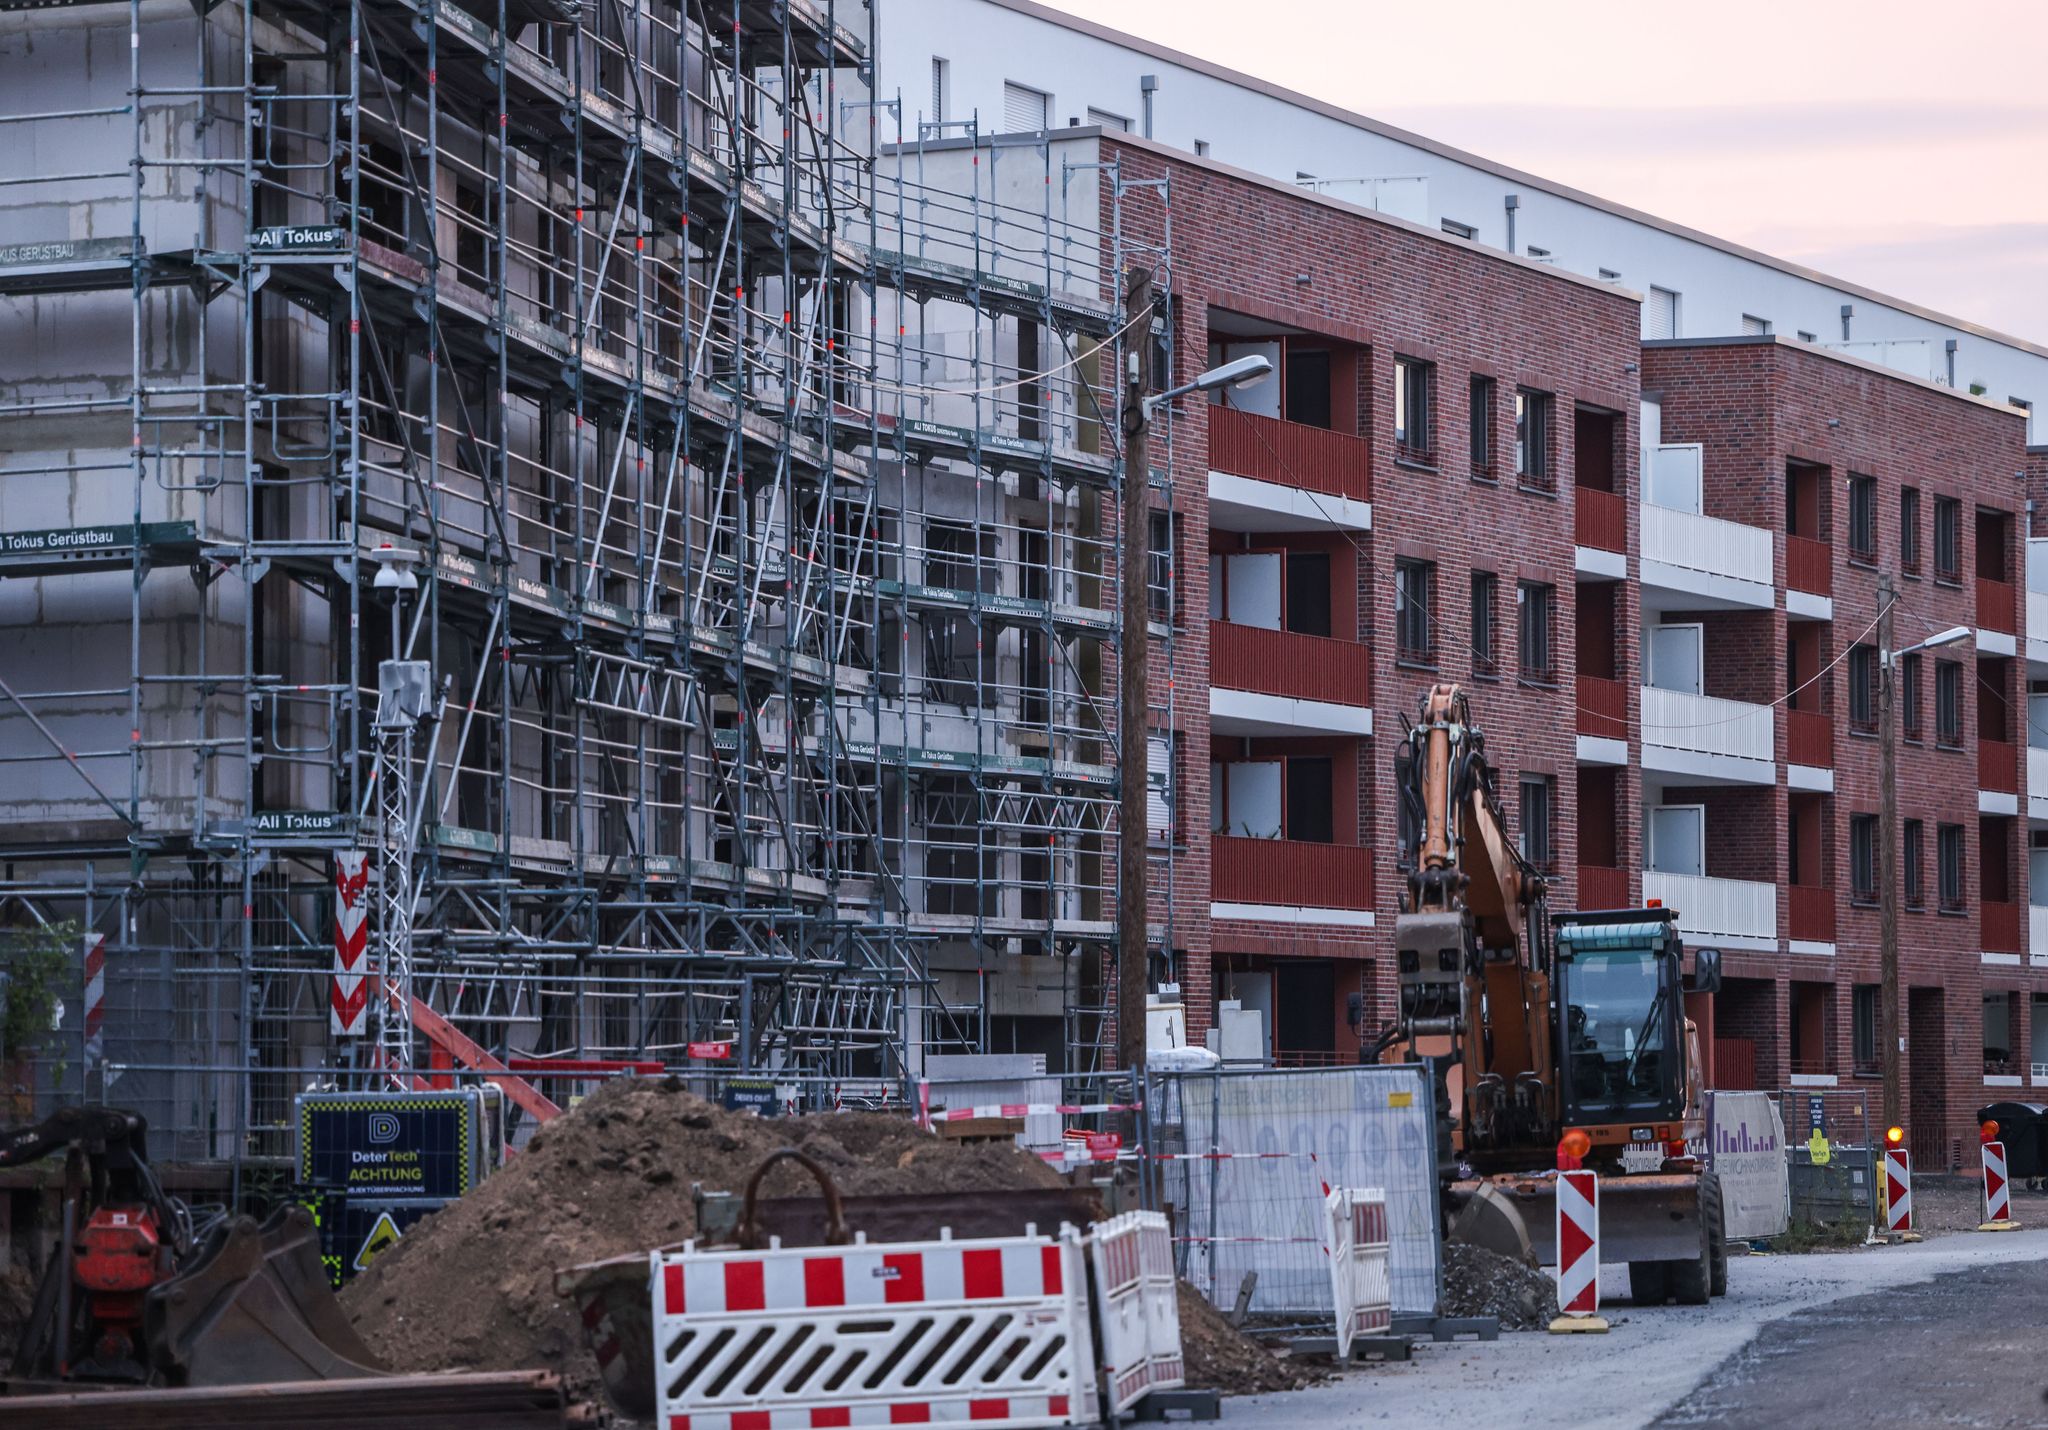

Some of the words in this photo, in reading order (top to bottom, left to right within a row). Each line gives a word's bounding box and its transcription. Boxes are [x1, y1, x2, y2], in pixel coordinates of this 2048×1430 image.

[259, 231, 280, 245] Ali
[284, 229, 333, 244] Tokus
[6, 534, 44, 549] Tokus
[48, 530, 113, 546] Gerüstbau
[258, 815, 280, 829] Ali
[284, 814, 332, 829] Tokus
[349, 1168, 422, 1181] ACHTUNG
